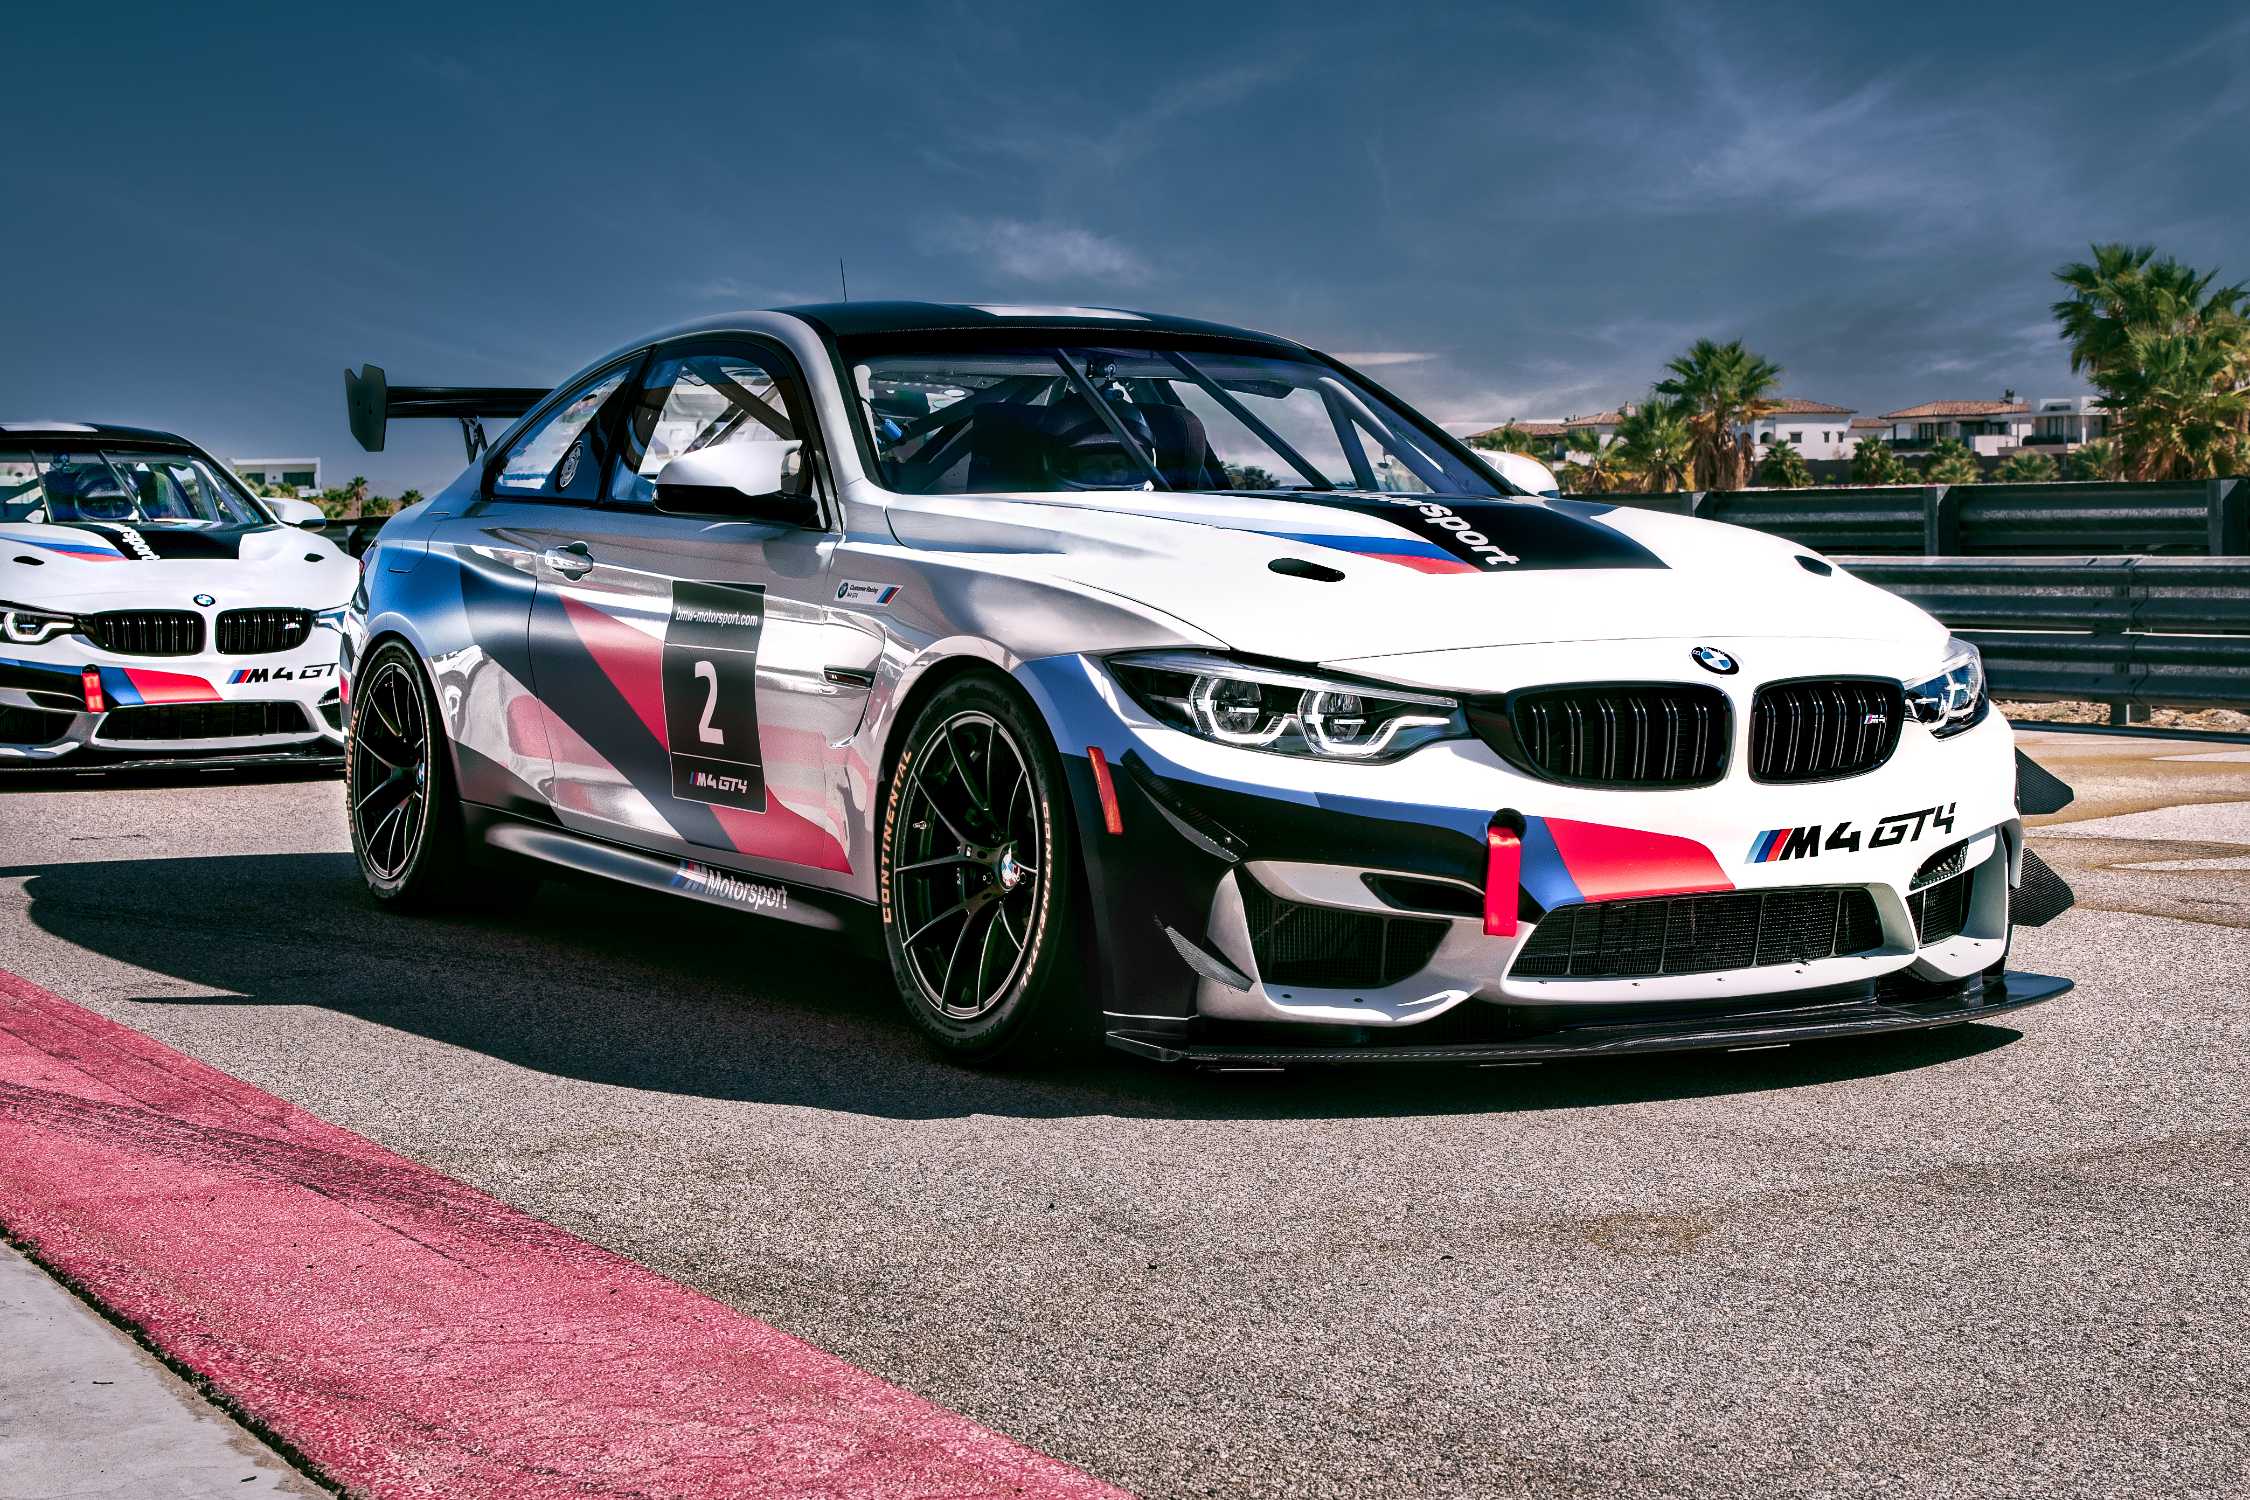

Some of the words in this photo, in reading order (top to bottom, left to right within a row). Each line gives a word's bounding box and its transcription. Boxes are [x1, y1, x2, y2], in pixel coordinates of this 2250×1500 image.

[675, 607, 758, 627] bmw-motorsport.com
[246, 667, 294, 683] M4
[299, 662, 339, 679] GT
[694, 660, 725, 745] 2
[696, 772, 717, 790] M4
[718, 775, 748, 794] GT4
[881, 750, 912, 924] CONTINENTAL
[1779, 821, 1862, 862] M4
[1868, 801, 1957, 849] GT4
[705, 868, 788, 911] Motorsport
[1017, 801, 1053, 991] CONTINENTAL
